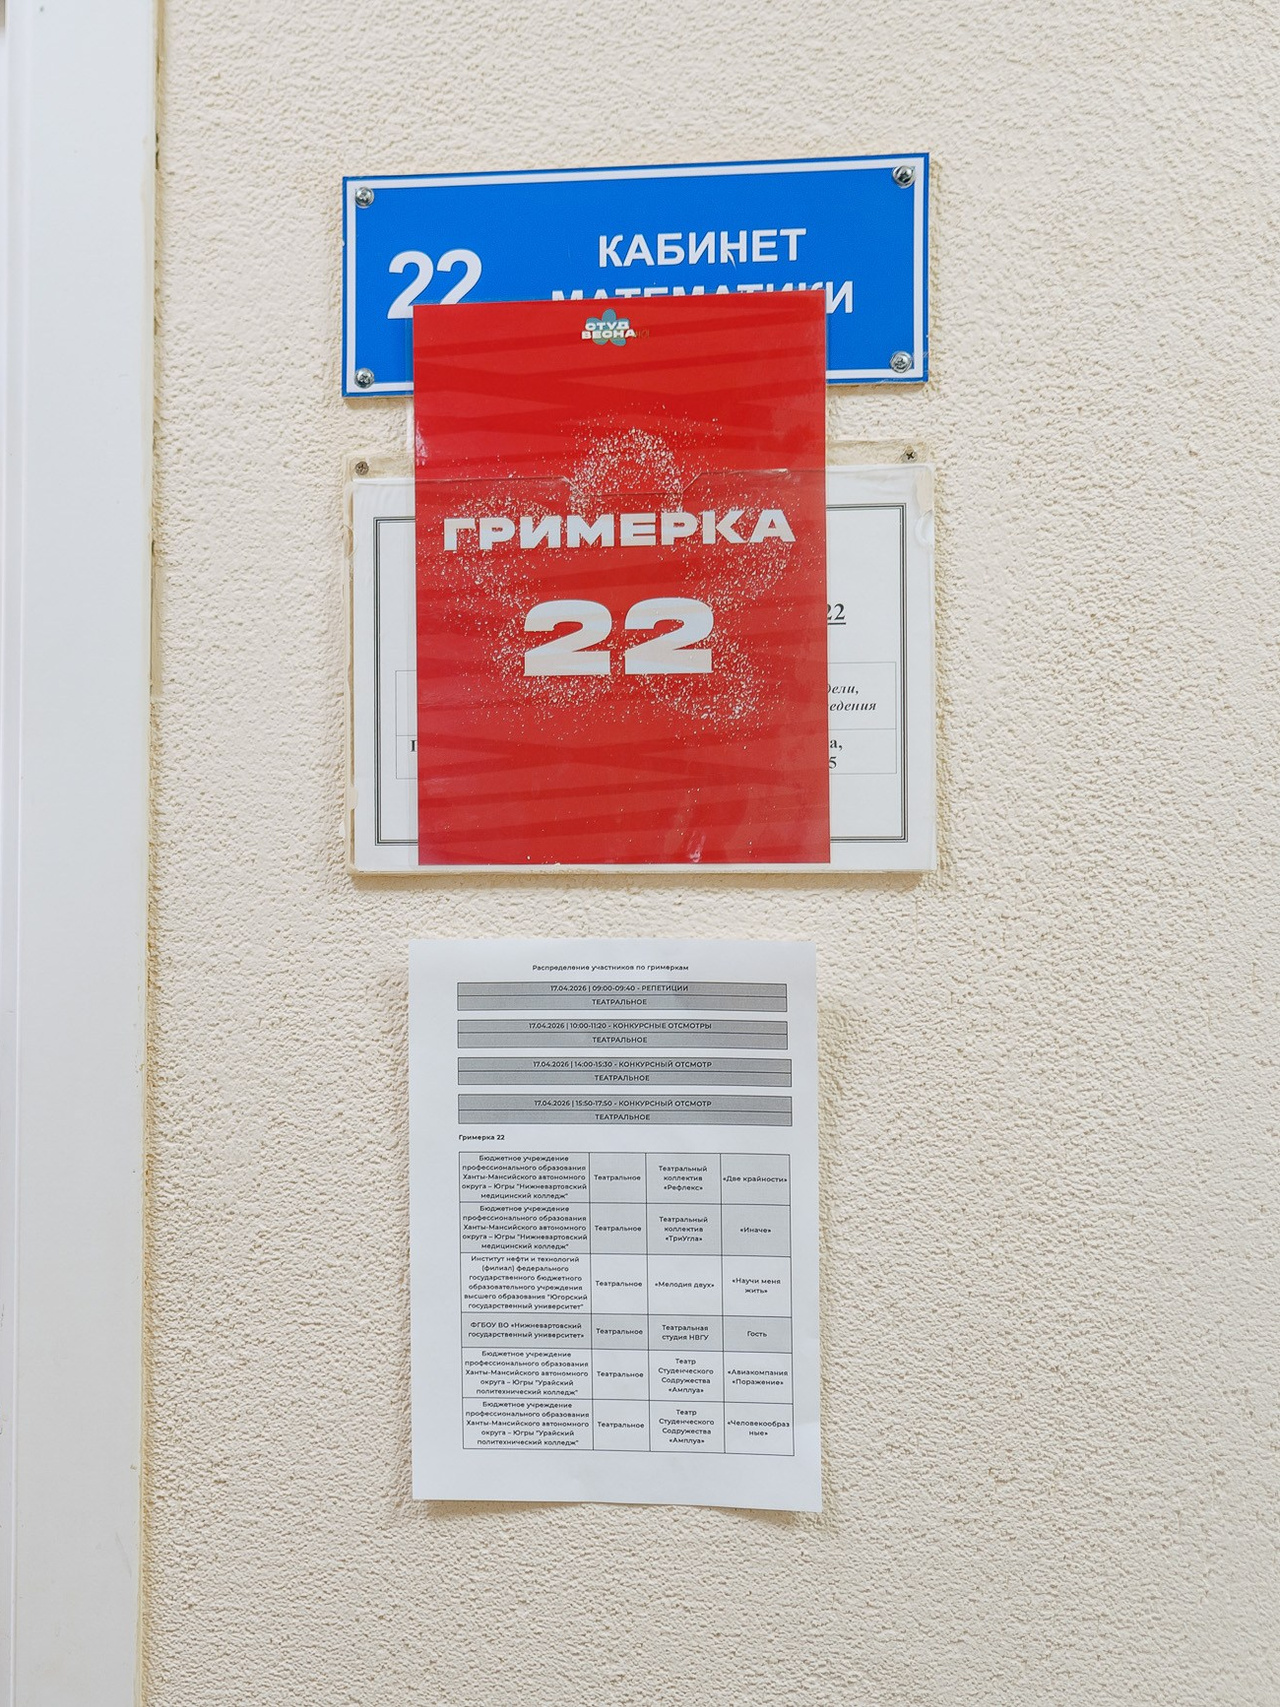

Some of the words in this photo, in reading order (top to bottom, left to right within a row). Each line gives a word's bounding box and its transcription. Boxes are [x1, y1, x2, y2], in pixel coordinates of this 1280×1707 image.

[599, 228, 807, 268] КАБИНЕТ
[387, 249, 482, 319] 22
[442, 509, 796, 551] ГРИМЕРКА
[523, 597, 715, 677] 22
[532, 964, 590, 972] Распределение
[618, 1060, 674, 1068] КОНКУРСНЫЙ
[618, 1099, 674, 1107] КОНКУРСНЫЙ
[537, 1164, 587, 1172] образования
[742, 1175, 788, 1183] крайности»
[538, 1214, 587, 1222] образования
[470, 1255, 505, 1263] Институт
[536, 1274, 583, 1282] бюджетного
[732, 1277, 760, 1285] «Научи
[468, 1283, 536, 1291] образовательного
[497, 1321, 510, 1329] ВО
[661, 1324, 709, 1332] Театральная
[468, 1331, 533, 1339] государственный
[540, 1360, 589, 1368] образования
[657, 1367, 714, 1375] Студенческого
[661, 1376, 711, 1385] Содружества
[732, 1378, 784, 1386] «Поражение»
[668, 1386, 704, 1394] «Амплуа»
[658, 1418, 715, 1426] Студенческого
[727, 1420, 790, 1428] «Человекообраз
[512, 1429, 535, 1437] Югры
[661, 1427, 712, 1435] Содружества
[669, 1437, 705, 1445] «Амплуа»
